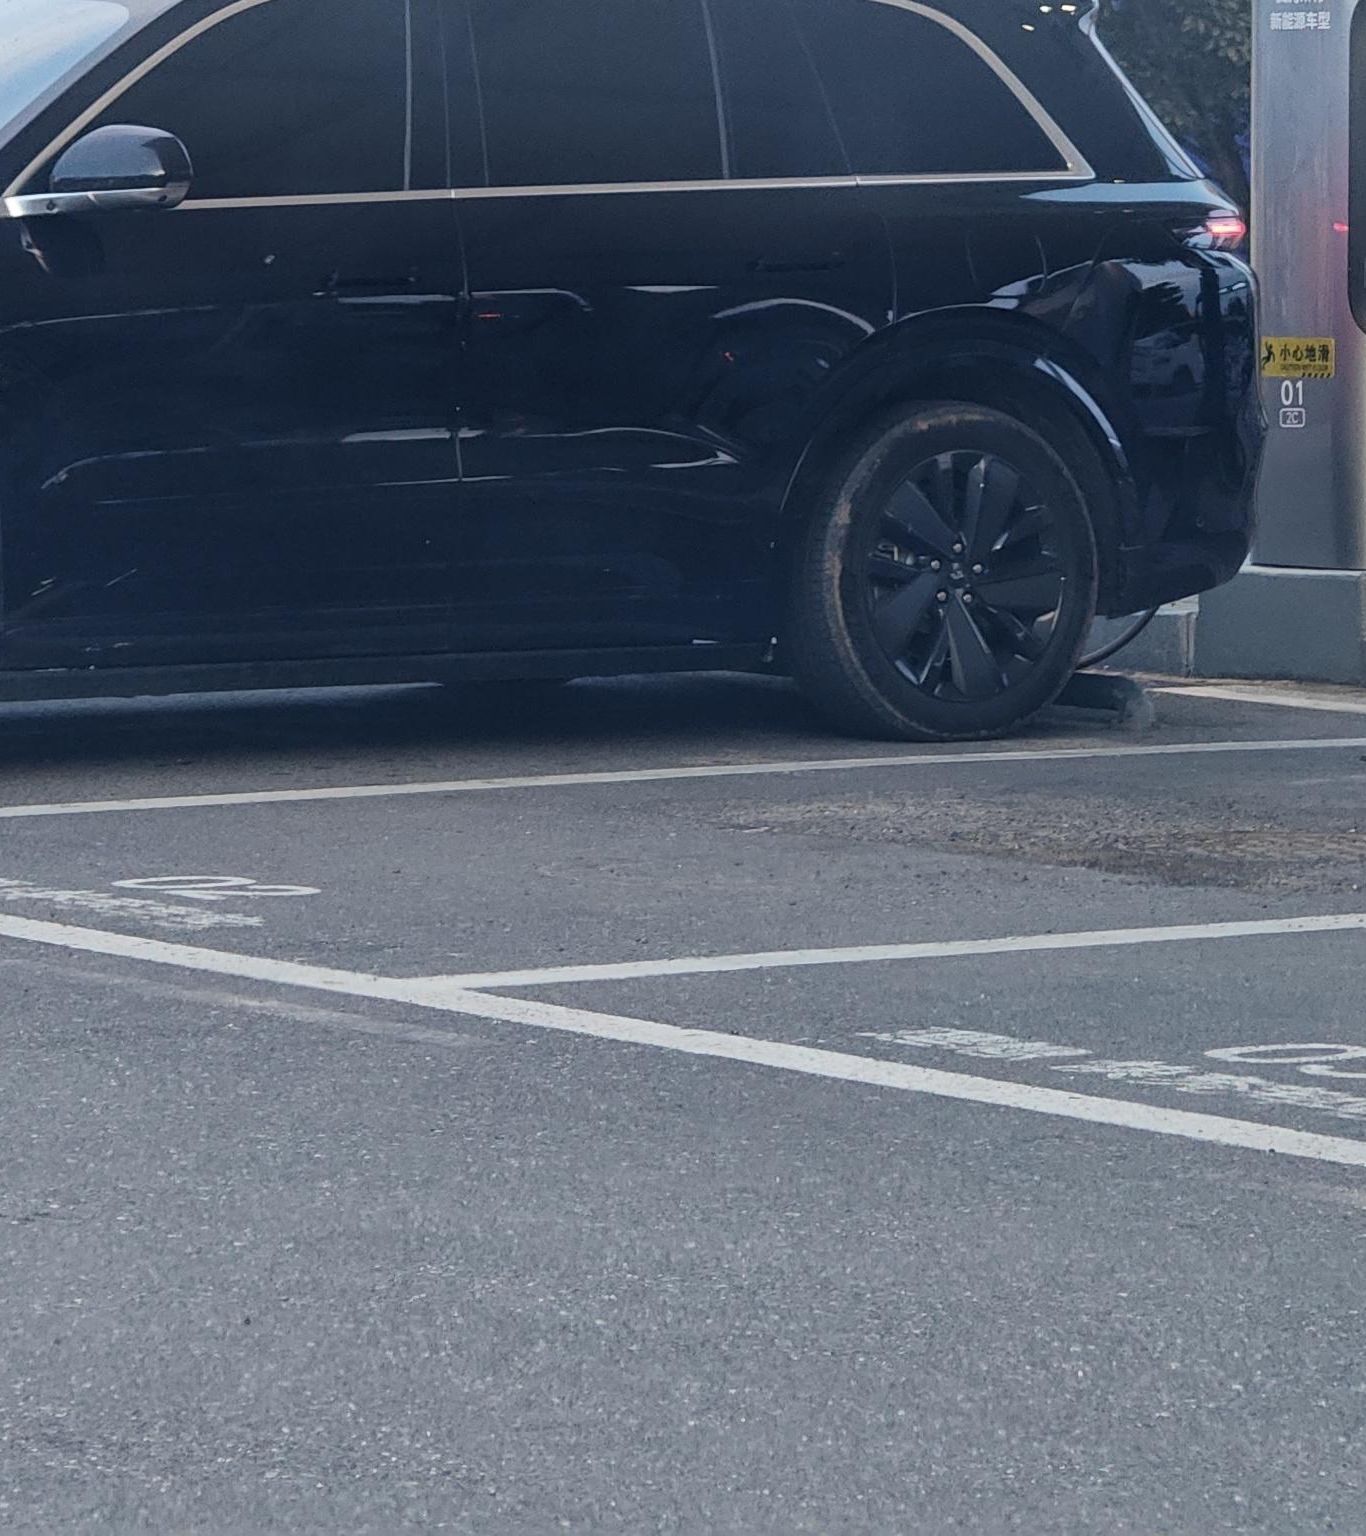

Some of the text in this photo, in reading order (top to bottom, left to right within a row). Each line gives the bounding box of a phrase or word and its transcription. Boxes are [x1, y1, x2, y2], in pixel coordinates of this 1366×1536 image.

[1270, 12, 1331, 31] 新能源车型
[1280, 344, 1329, 363] 小心地滑
[1280, 380, 1303, 406] 01
[1286, 412, 1299, 423] 2C
[112, 875, 321, 900] 02
